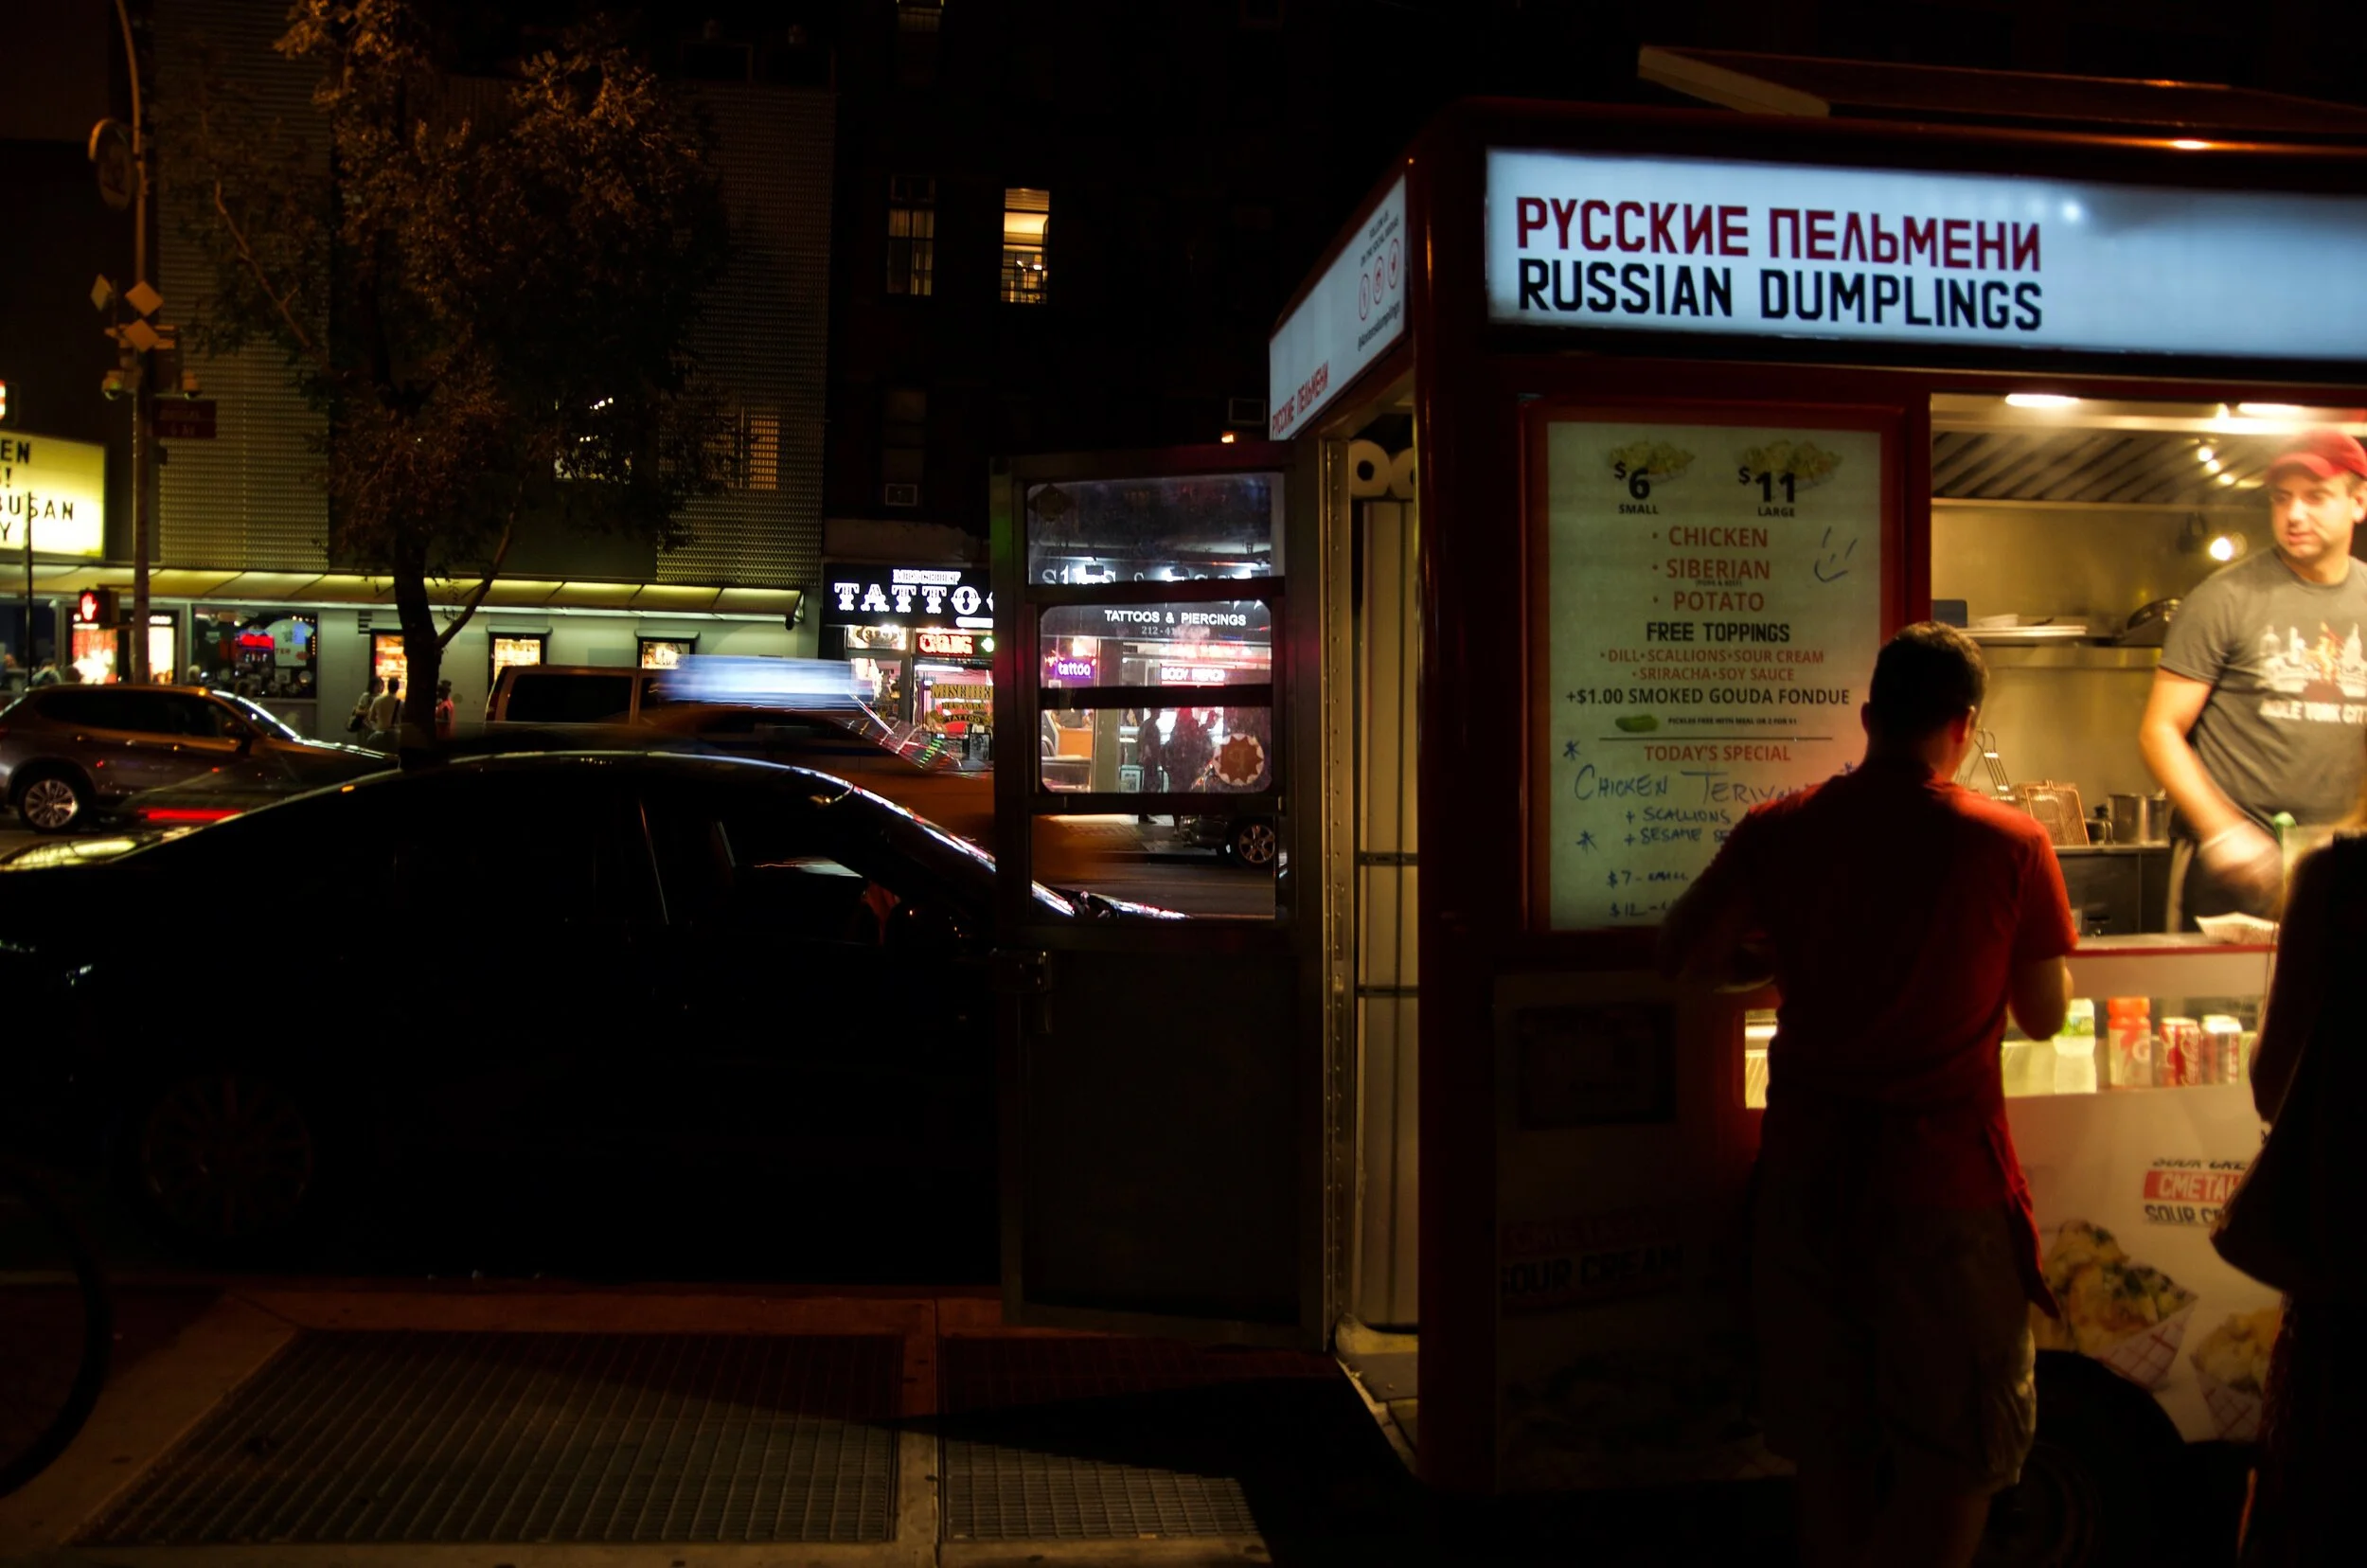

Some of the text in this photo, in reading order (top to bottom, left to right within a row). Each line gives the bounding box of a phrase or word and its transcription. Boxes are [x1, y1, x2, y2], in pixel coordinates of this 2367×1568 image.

[1517, 197, 2040, 272] РУССКИЕ ПЕЛЬМЕНИ
[1519, 258, 2041, 330] RUSSIAN DUMPLINGS
[0, 495, 73, 521] USAN
[1618, 504, 1795, 518] SMALL LARGE
[1668, 526, 1769, 547] CHICKEN
[1666, 559, 1771, 579] SIBERIAN
[834, 582, 993, 615] TATTO
[1673, 592, 1765, 611] POTATO
[1105, 610, 1247, 626] TATTOOS & PIERCINGS
[1646, 622, 1790, 642] FREE TOPPINGS
[1648, 650, 1726, 663] SCALLIONS
[1734, 650, 1771, 663] SOUR
[1776, 650, 1824, 663] CREAM
[1058, 662, 1091, 676] tattoo
[1640, 668, 1794, 682] SRIRACHA SOY SAUCE
[1566, 688, 1849, 706] +$1.00 SMOKED GOUDA FONDUE
[948, 714, 981, 722] TATTOO
[1645, 745, 1791, 761] TODAY'S SPECIAL
[1643, 809, 1731, 825] SCALLIONS
[1640, 826, 1702, 845] SESAME
[2158, 1171, 2240, 1202] СМЕТАН
